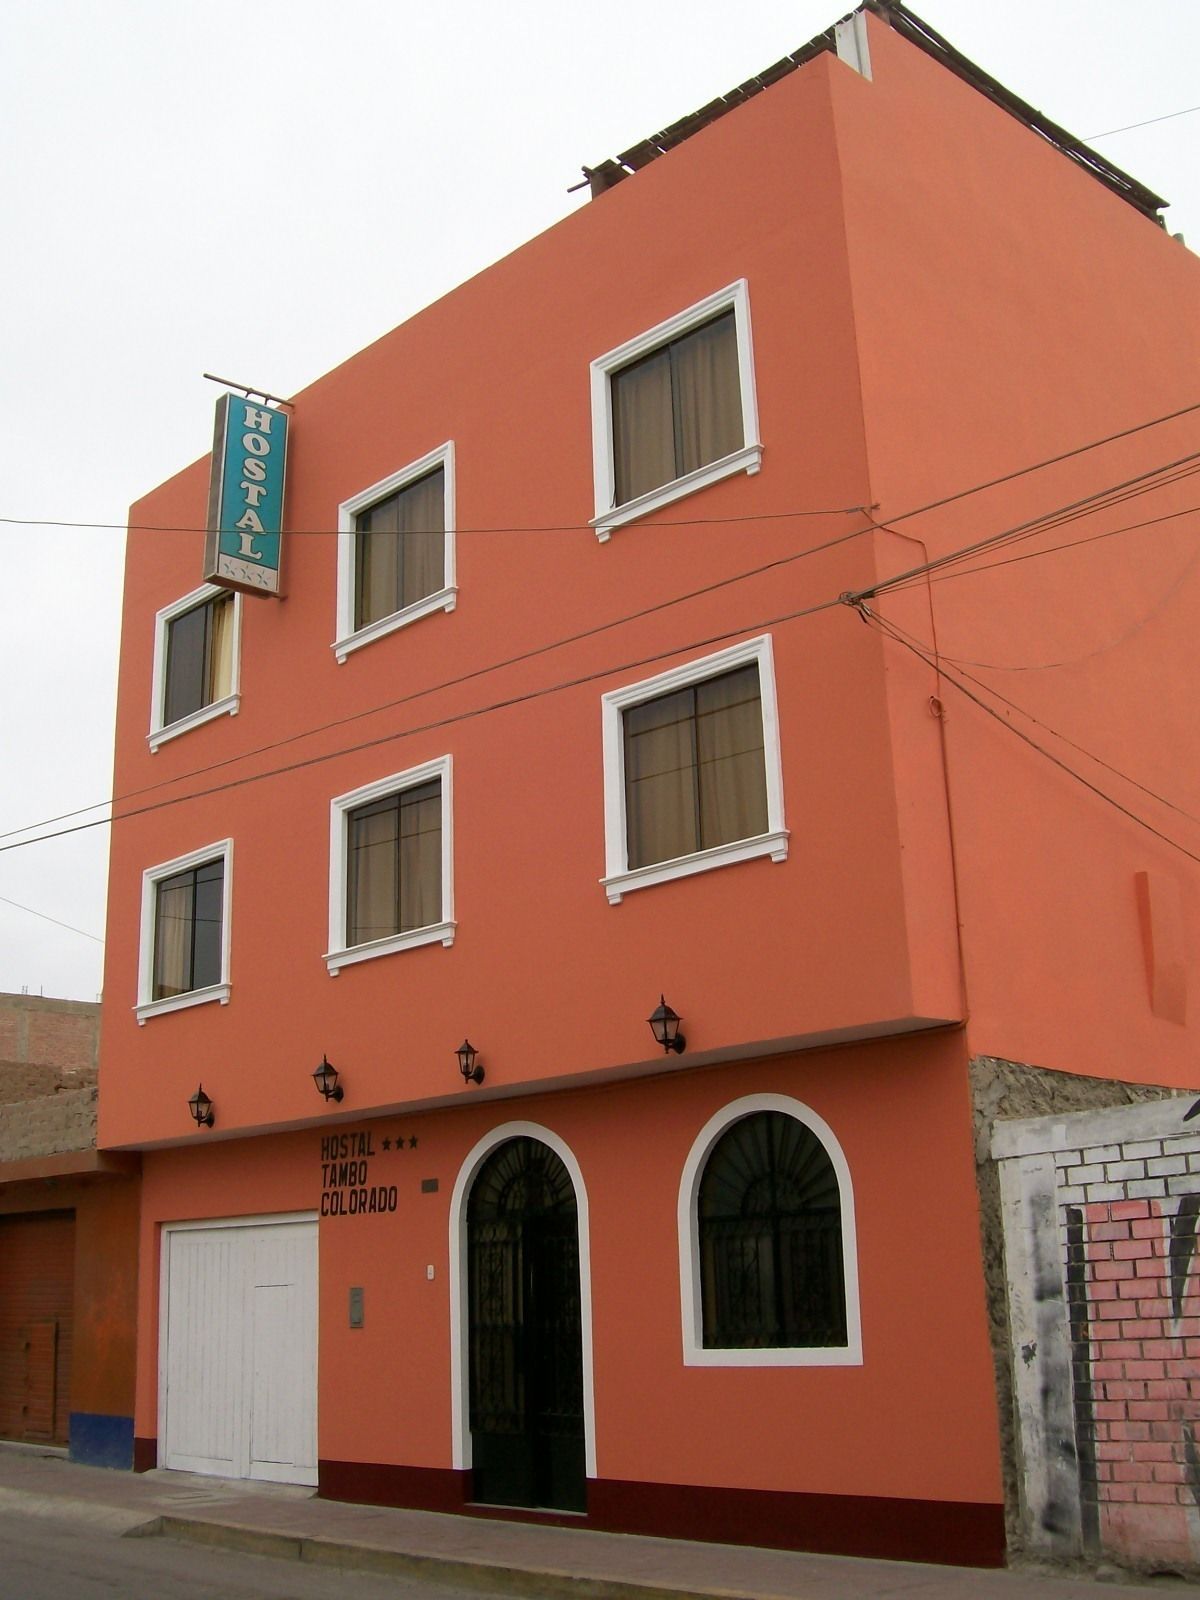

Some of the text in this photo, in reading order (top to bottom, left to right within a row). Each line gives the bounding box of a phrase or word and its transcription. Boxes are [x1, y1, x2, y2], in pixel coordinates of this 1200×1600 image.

[235, 405, 273, 560] HOSTAL
[321, 1131, 375, 1161] HOSTAL
[321, 1160, 367, 1188] TAMBO
[321, 1186, 398, 1216] COLORADO
